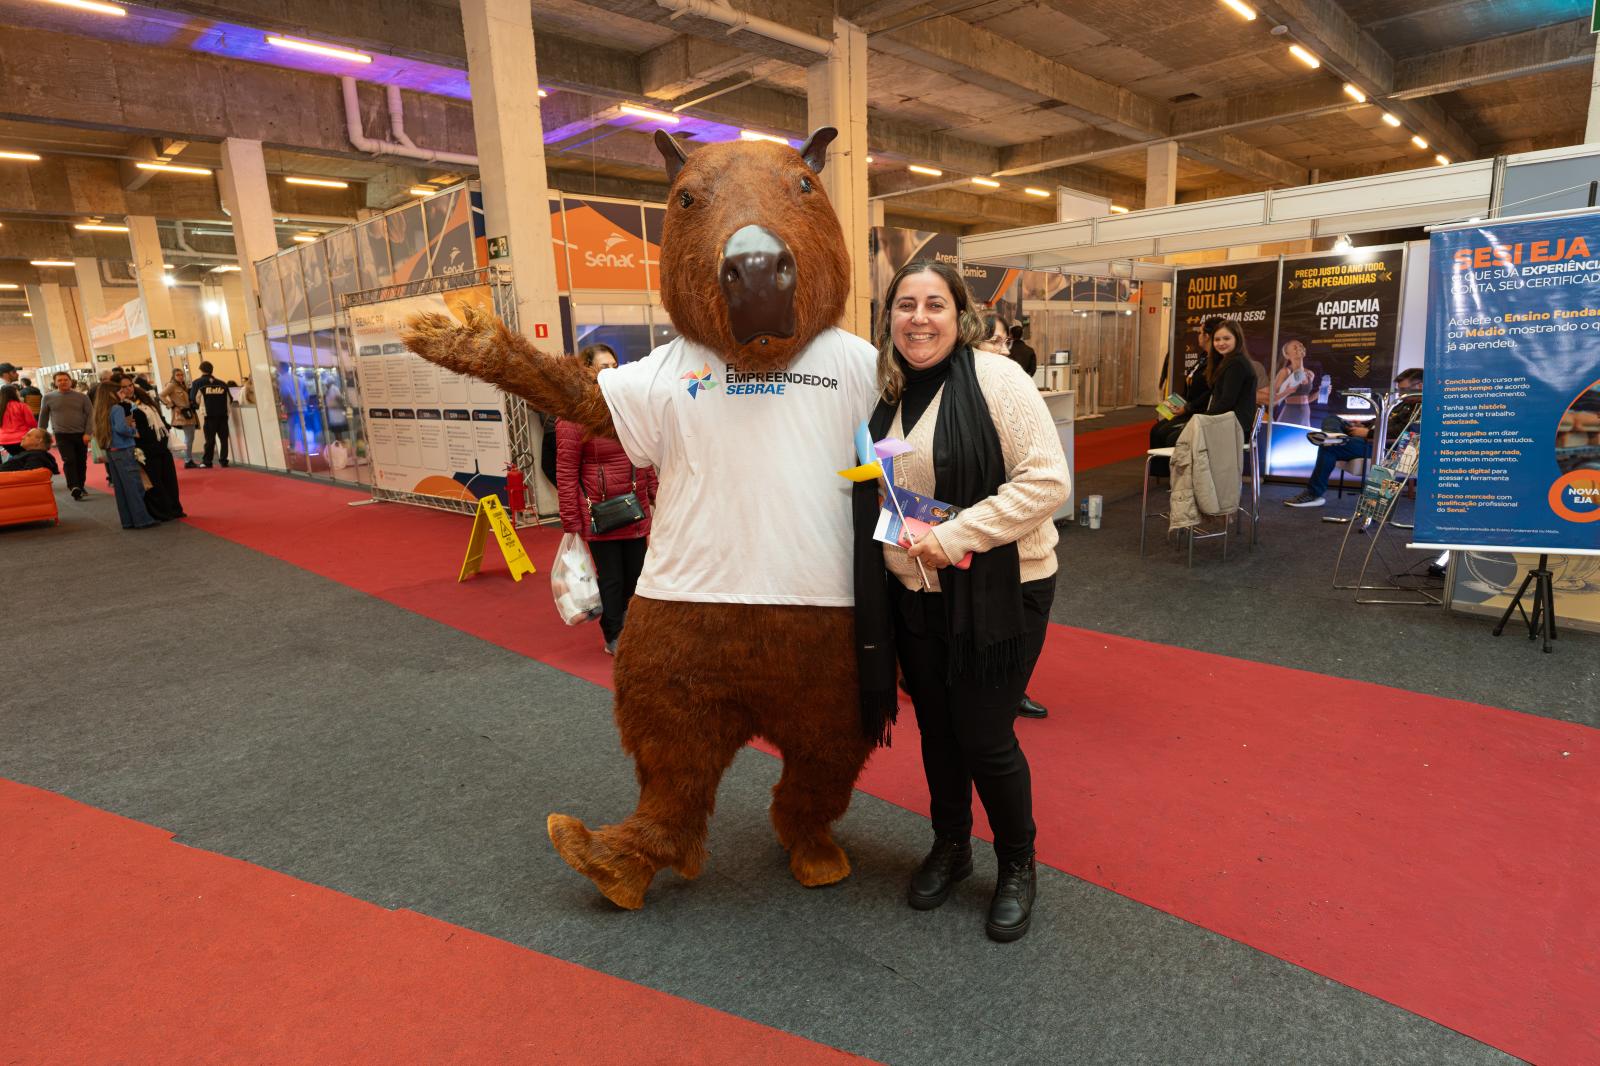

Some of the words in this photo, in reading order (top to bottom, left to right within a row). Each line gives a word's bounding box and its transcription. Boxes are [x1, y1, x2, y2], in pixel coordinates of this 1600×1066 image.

[585, 250, 635, 268] Senac
[1453, 243, 1522, 270] SESI
[1530, 236, 1590, 262] EJA
[1295, 268, 1318, 278] PREÇO
[1318, 266, 1340, 276] JUSTO
[1347, 263, 1364, 273] ANO
[1465, 270, 1492, 282] QUE
[1494, 267, 1519, 279] SUA
[1187, 276, 1217, 294] AQUI
[1219, 274, 1238, 290] NO
[1302, 278, 1321, 288] SEM
[1321, 273, 1377, 287] PEGADINHAS
[1498, 280, 1524, 290] SEU
[1187, 292, 1233, 310] OUTLET
[1315, 298, 1380, 316] ACADEMIA
[1243, 310, 1267, 322] SESC
[1320, 316, 1328, 330] E
[1329, 314, 1379, 330] PILATES
[1448, 316, 1492, 327] Acelere
[1494, 316, 1503, 324] o
[1504, 310, 1551, 323] Ensino
[1448, 331, 1463, 339] ou
[1465, 326, 1506, 337] Médio
[1508, 322, 1578, 335] mostrando
[1581, 322, 1589, 330] o
[1445, 342, 1457, 354] já
[1459, 339, 1518, 352] aprendeu.
[726, 372, 838, 391] EMPREENDEDOR
[1444, 377, 1480, 385] Conclusão
[726, 384, 786, 395] SEBRAE
[1473, 391, 1527, 399] conhecimento.
[1568, 488, 1600, 496] NOVA
[1574, 496, 1593, 504] EJA
